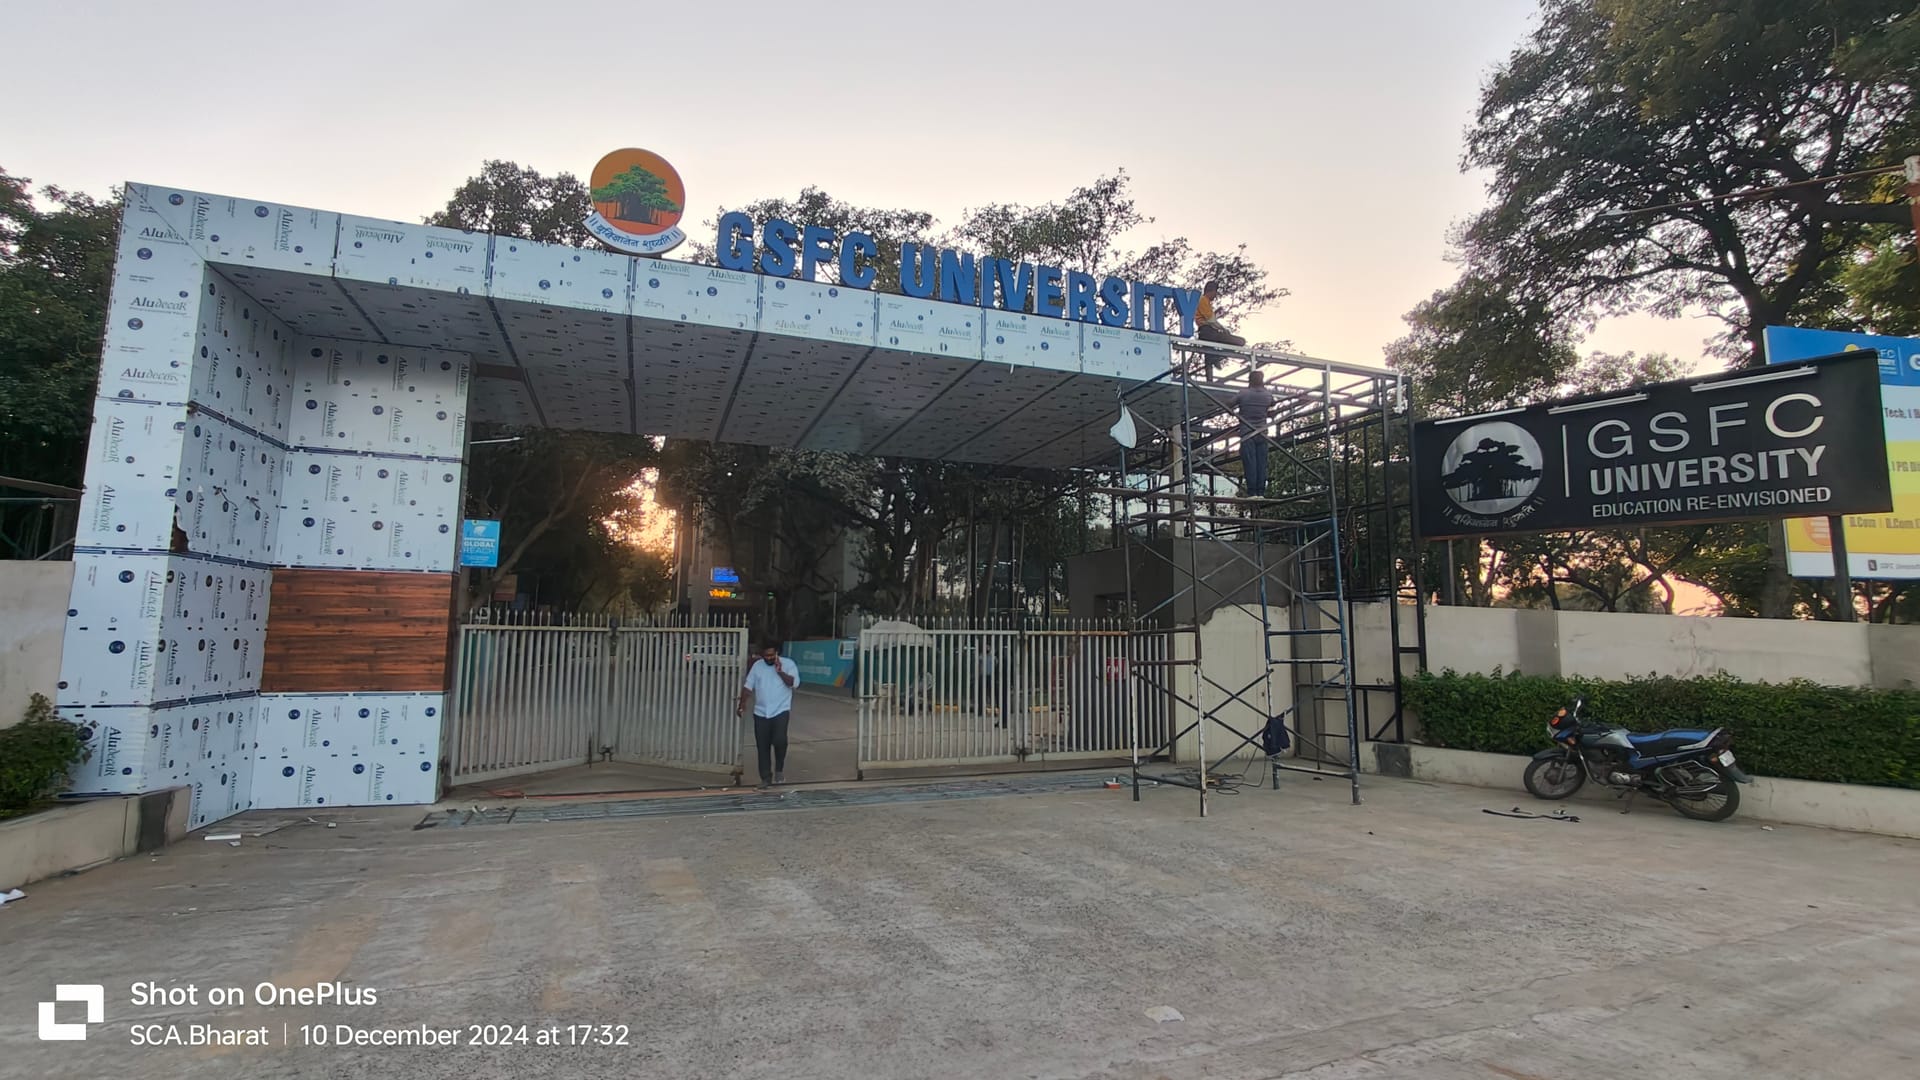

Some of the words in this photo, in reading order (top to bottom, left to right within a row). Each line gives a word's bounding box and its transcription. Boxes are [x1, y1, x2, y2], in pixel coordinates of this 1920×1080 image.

[717, 211, 877, 289] GSFC
[900, 241, 1200, 338] UNIVERSITY
[1587, 393, 1824, 459] GSFC
[1590, 445, 1826, 496] UNIVERSITY
[1592, 498, 1682, 518] EDUCATION
[1687, 487, 1831, 511] RE-ENVISIONED
